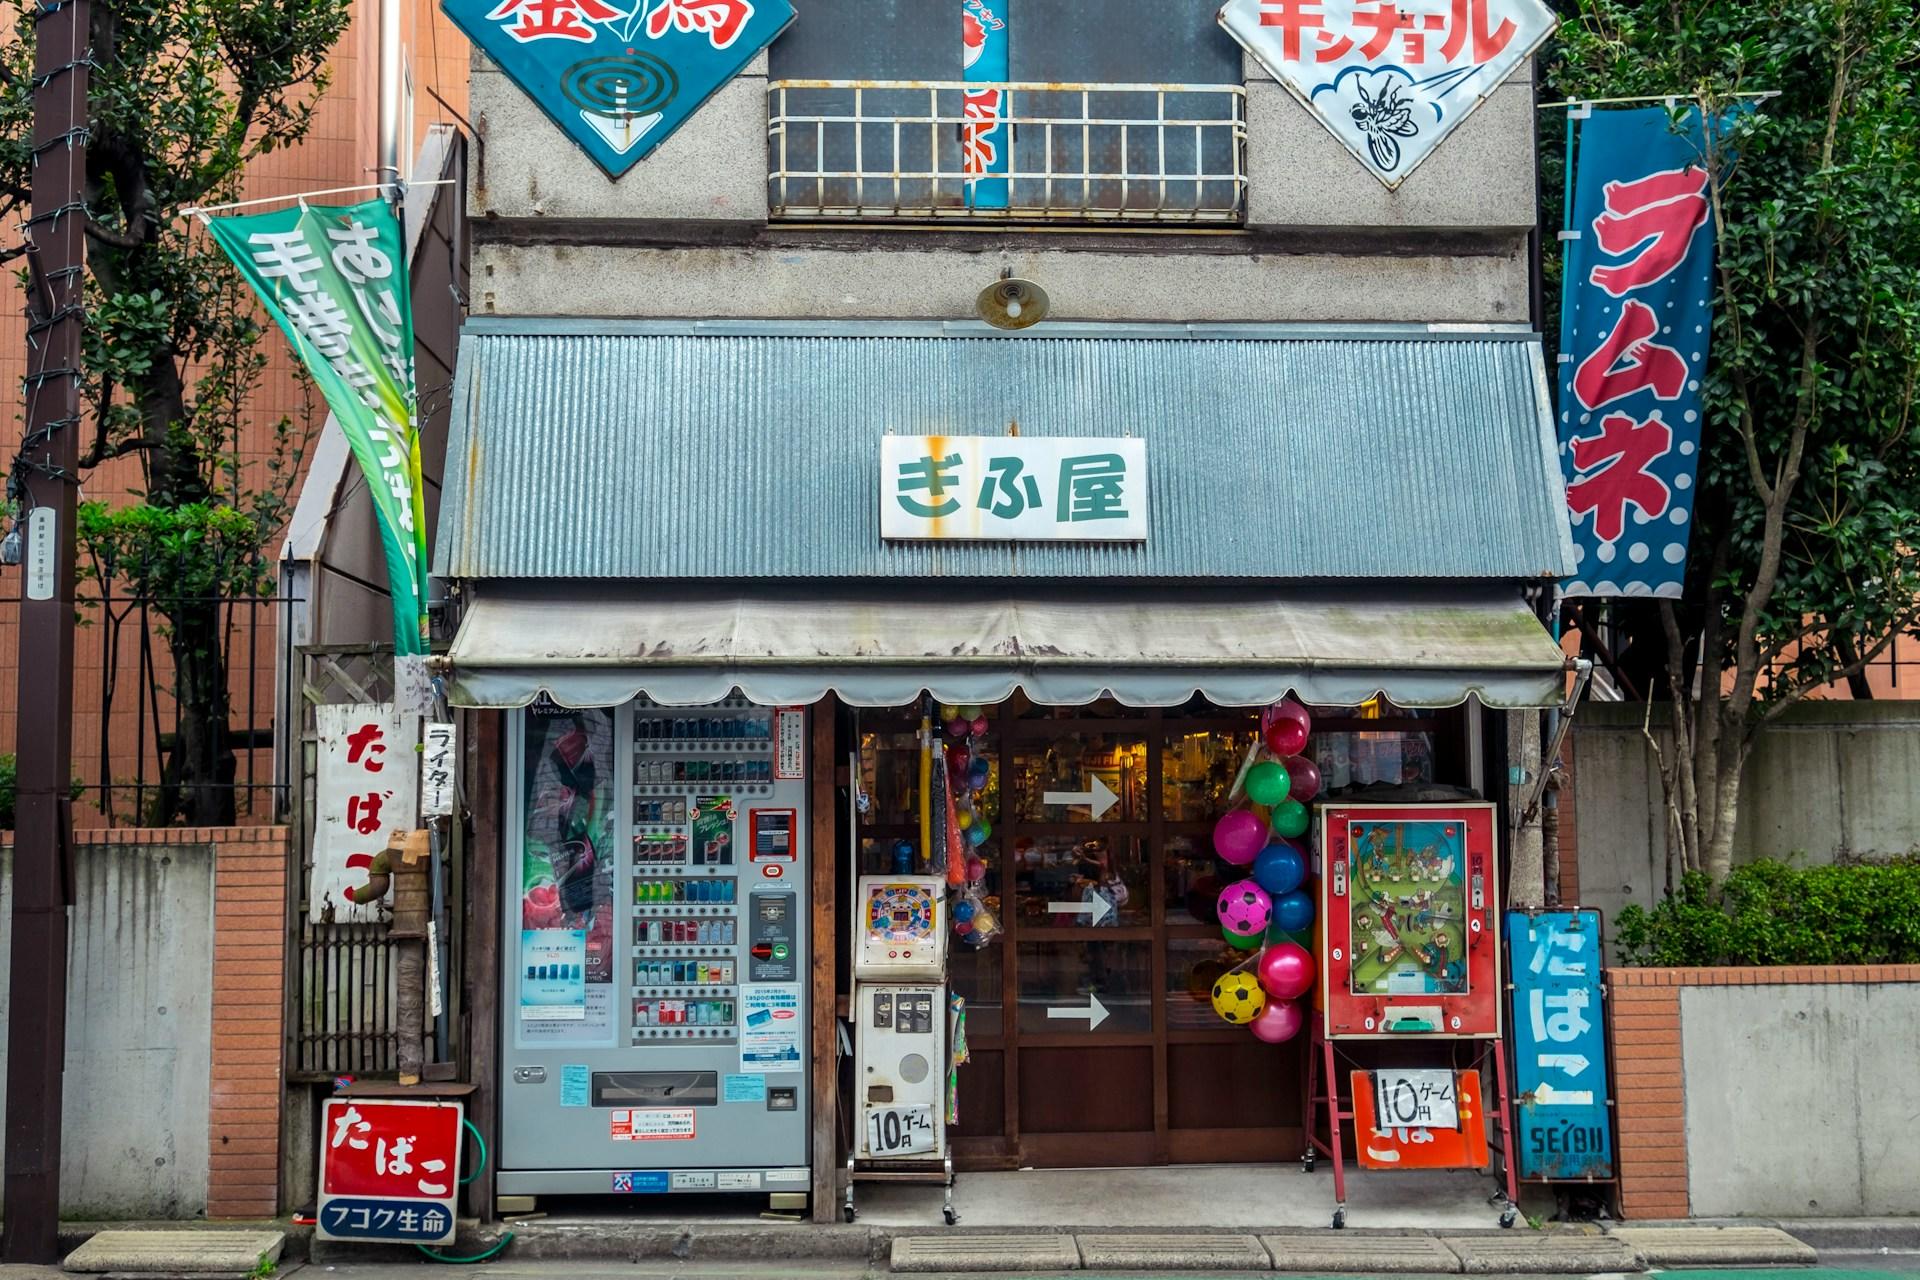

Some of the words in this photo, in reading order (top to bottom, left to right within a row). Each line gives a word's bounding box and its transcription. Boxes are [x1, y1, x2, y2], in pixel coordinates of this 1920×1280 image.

[1259, 0, 1517, 64] キンチョール
[1567, 165, 1710, 543] ラムネ
[896, 452, 1129, 523] ぎふ屋
[429, 730, 450, 808] ライター
[332, 1107, 448, 1195] たばこ
[329, 1207, 446, 1233] フコク生命
